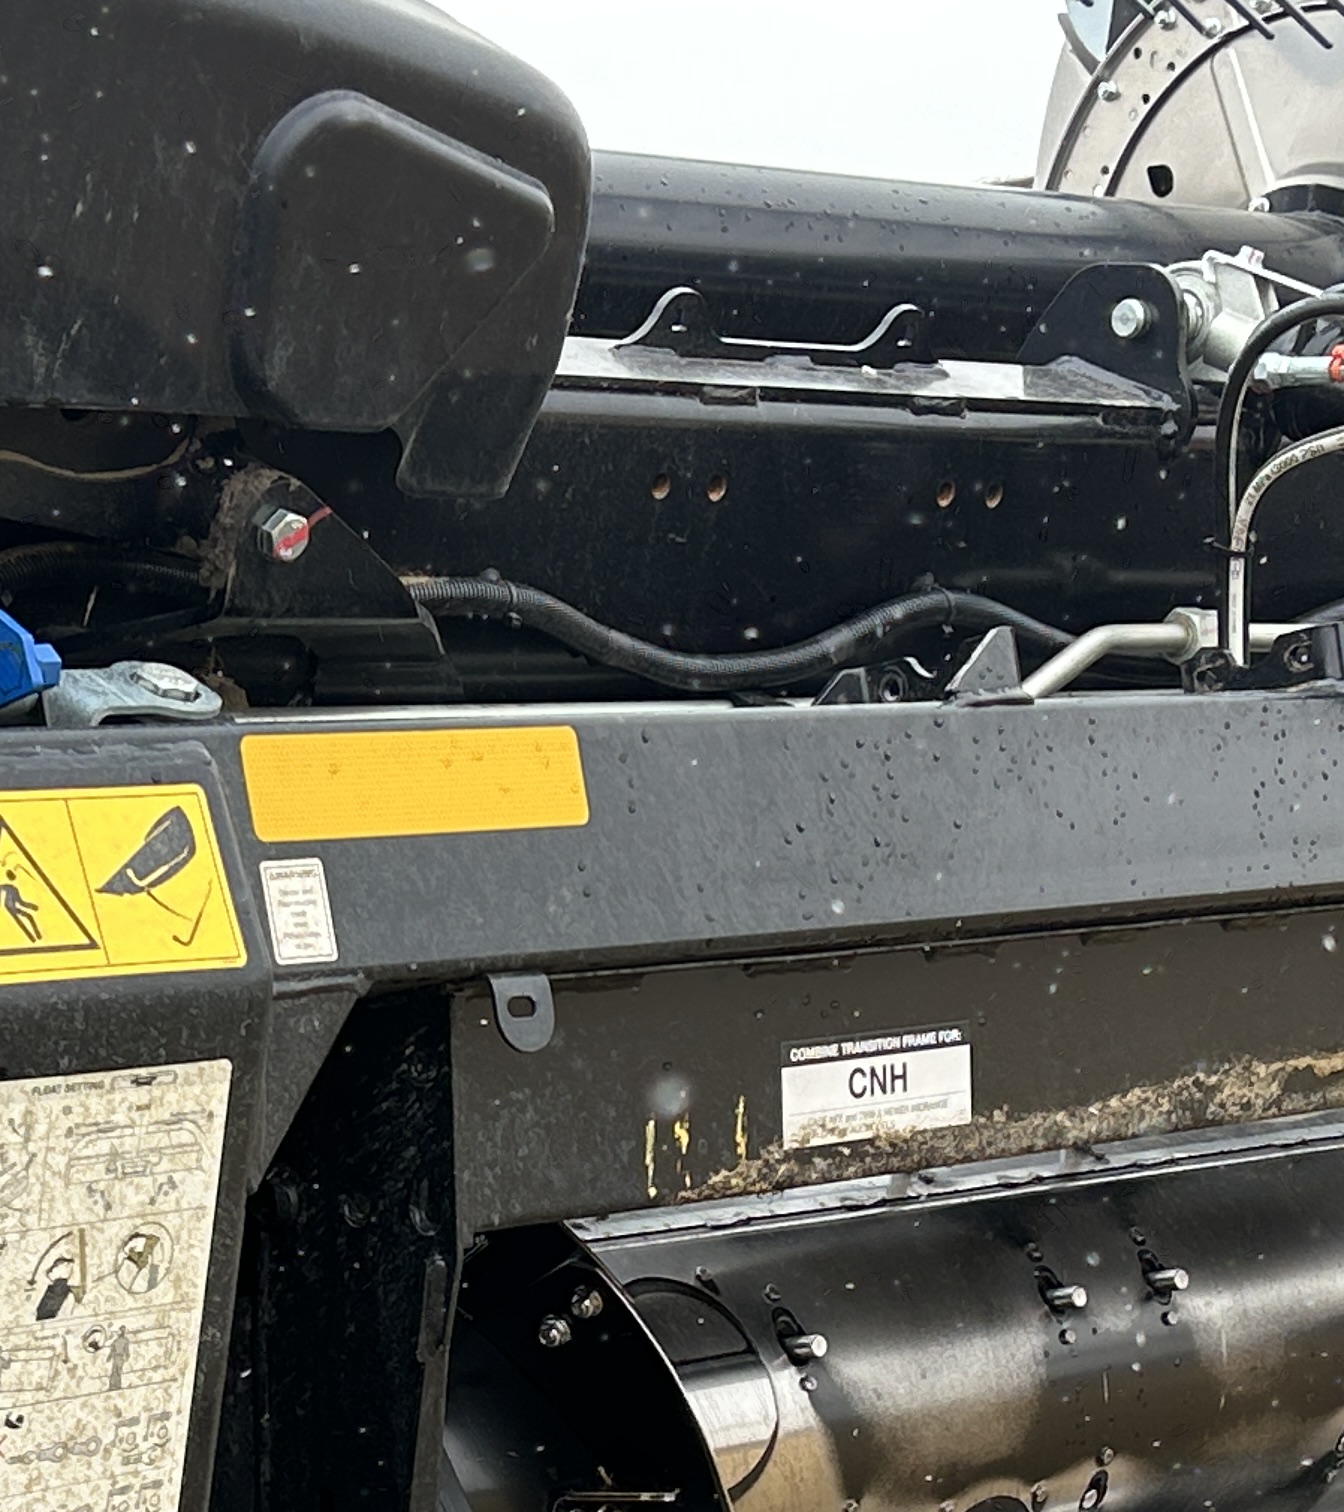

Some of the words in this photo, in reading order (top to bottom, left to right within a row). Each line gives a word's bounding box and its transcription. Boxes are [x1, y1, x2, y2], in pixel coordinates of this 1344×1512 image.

[789, 1043, 840, 1062] COMBINE
[840, 1035, 902, 1056] TRANSITION
[902, 1031, 938, 1048] FRAME
[848, 1062, 908, 1099] CNH
